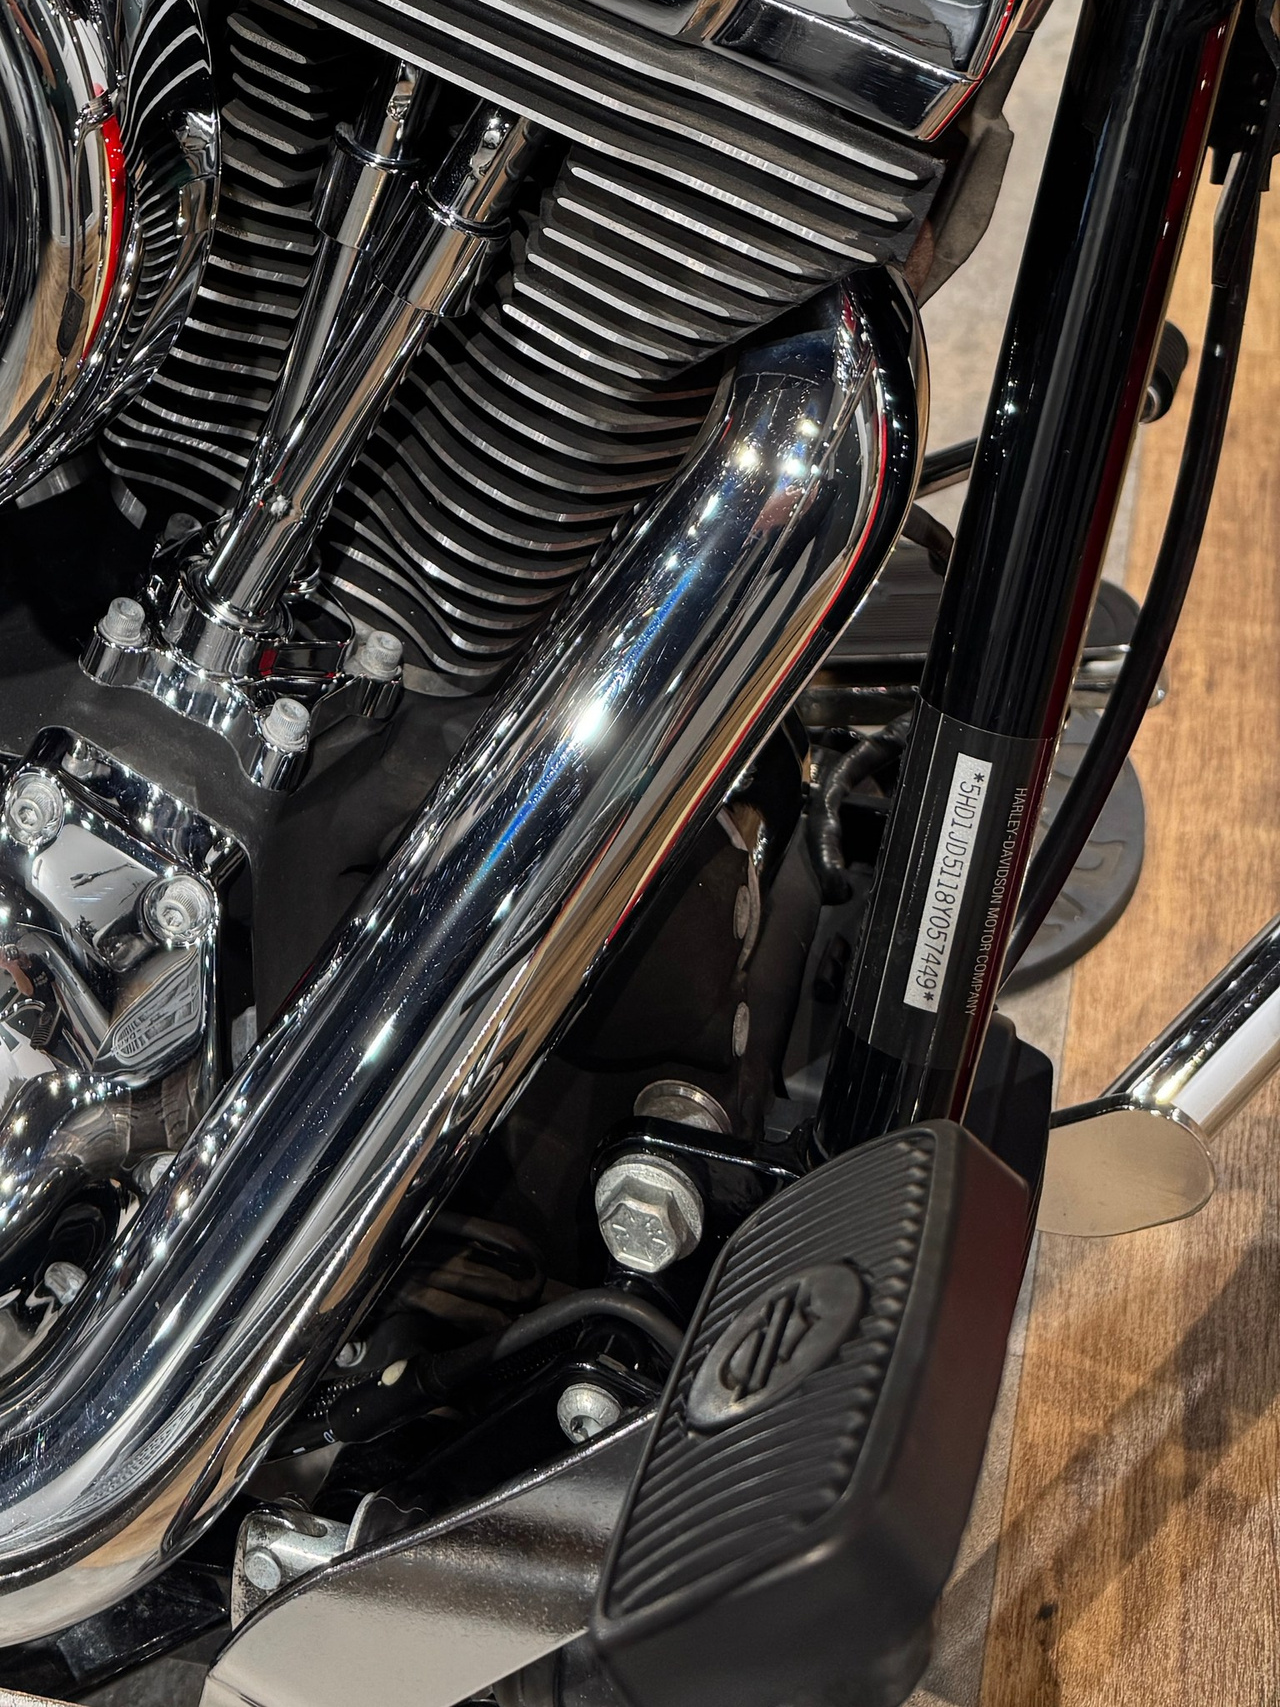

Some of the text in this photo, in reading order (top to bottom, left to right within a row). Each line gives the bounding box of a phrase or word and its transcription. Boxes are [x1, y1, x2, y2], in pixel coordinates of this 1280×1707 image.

[965, 787, 1028, 1015] HARLEY-DAVIDSON MOTOR COMPANY
